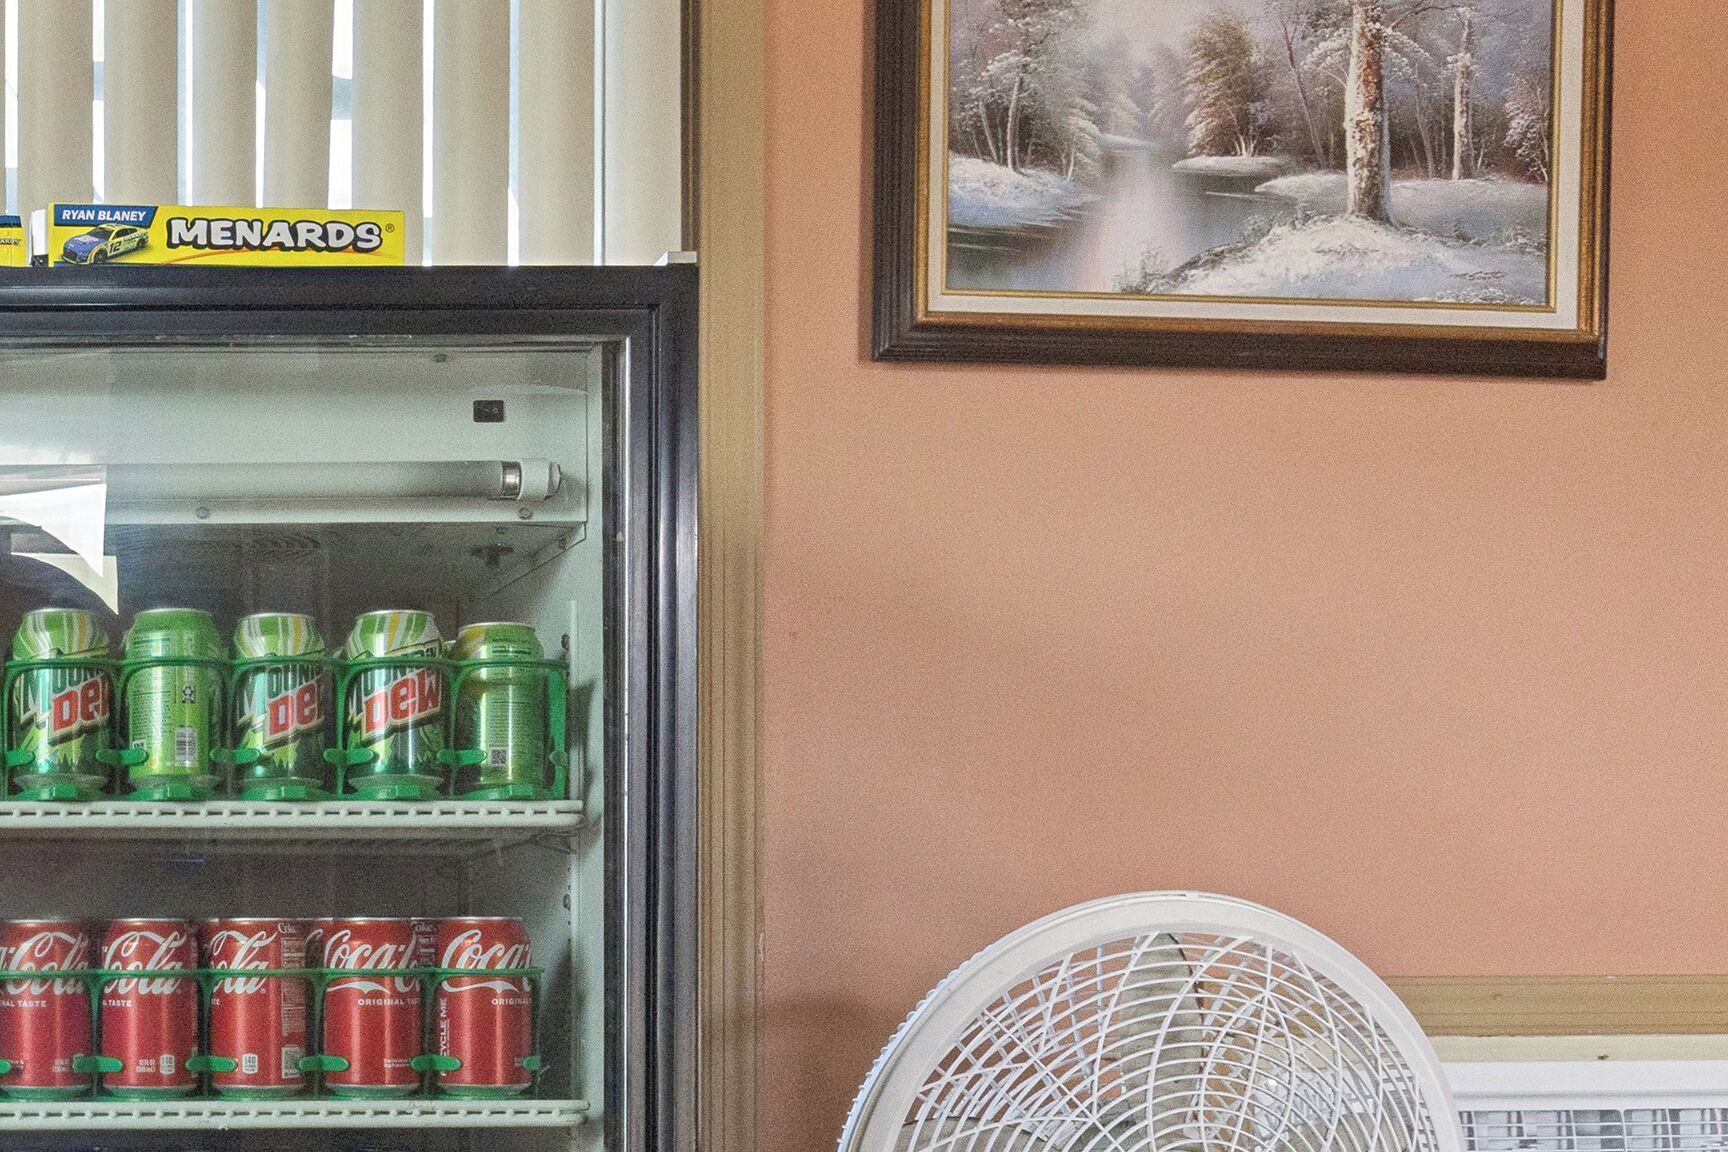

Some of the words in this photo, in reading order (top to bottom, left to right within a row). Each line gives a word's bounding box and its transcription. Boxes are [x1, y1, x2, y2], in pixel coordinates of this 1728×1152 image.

[62, 210, 96, 220] RYAN
[98, 210, 146, 221] BLANEY
[167, 216, 383, 252] MENARDS
[109, 242, 121, 254] 12
[357, 998, 405, 1006] ORIGINAL
